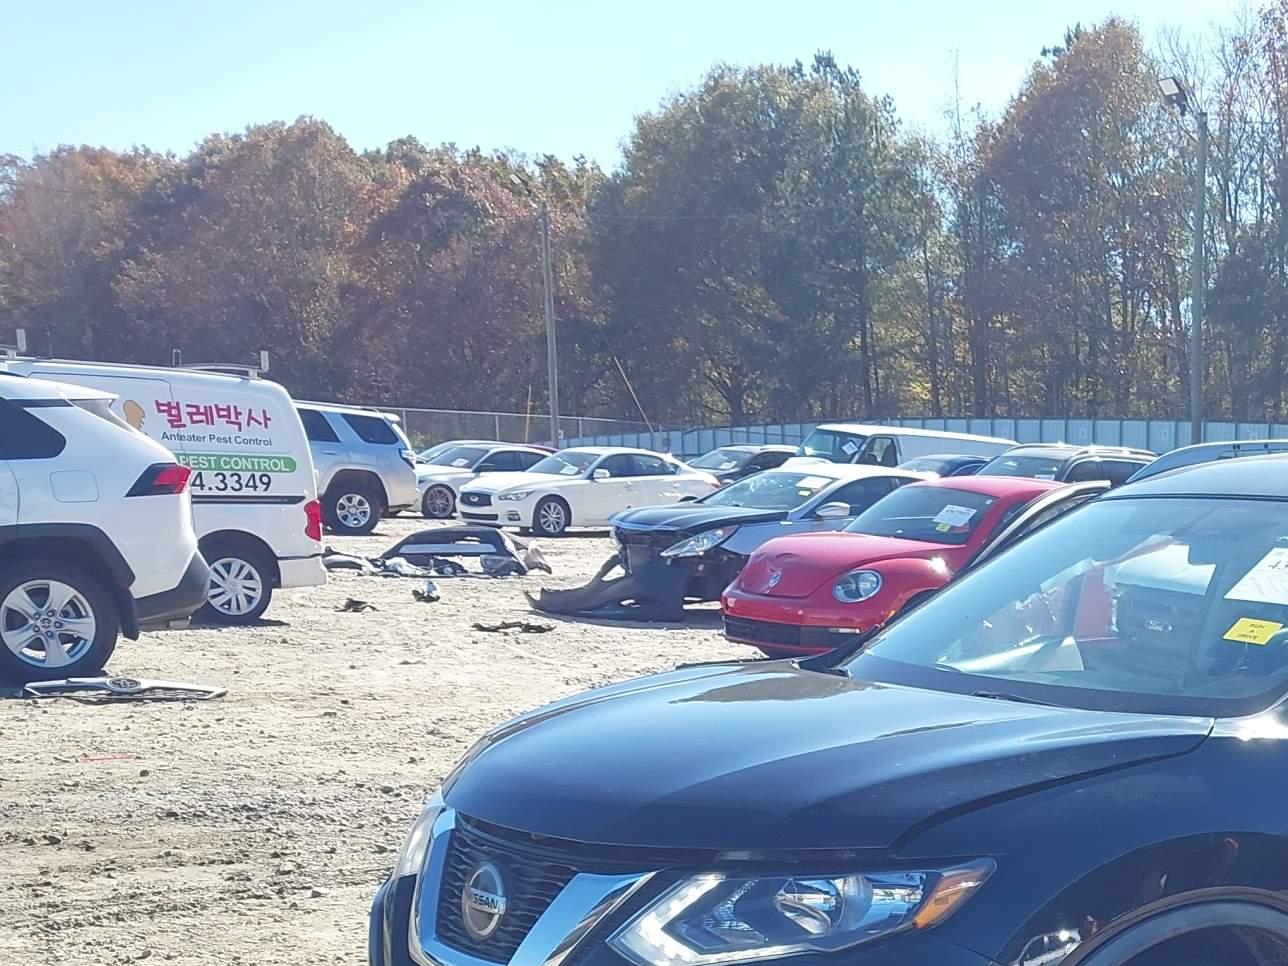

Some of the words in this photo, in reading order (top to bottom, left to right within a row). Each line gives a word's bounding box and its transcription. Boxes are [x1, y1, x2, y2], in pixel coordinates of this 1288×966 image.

[155, 400, 272, 432] 벌레박사
[161, 431, 206, 443] Anteater
[209, 434, 232, 445] Pest
[234, 434, 273, 447] Control
[180, 455, 217, 469] PEST
[220, 456, 291, 472] CONTROL
